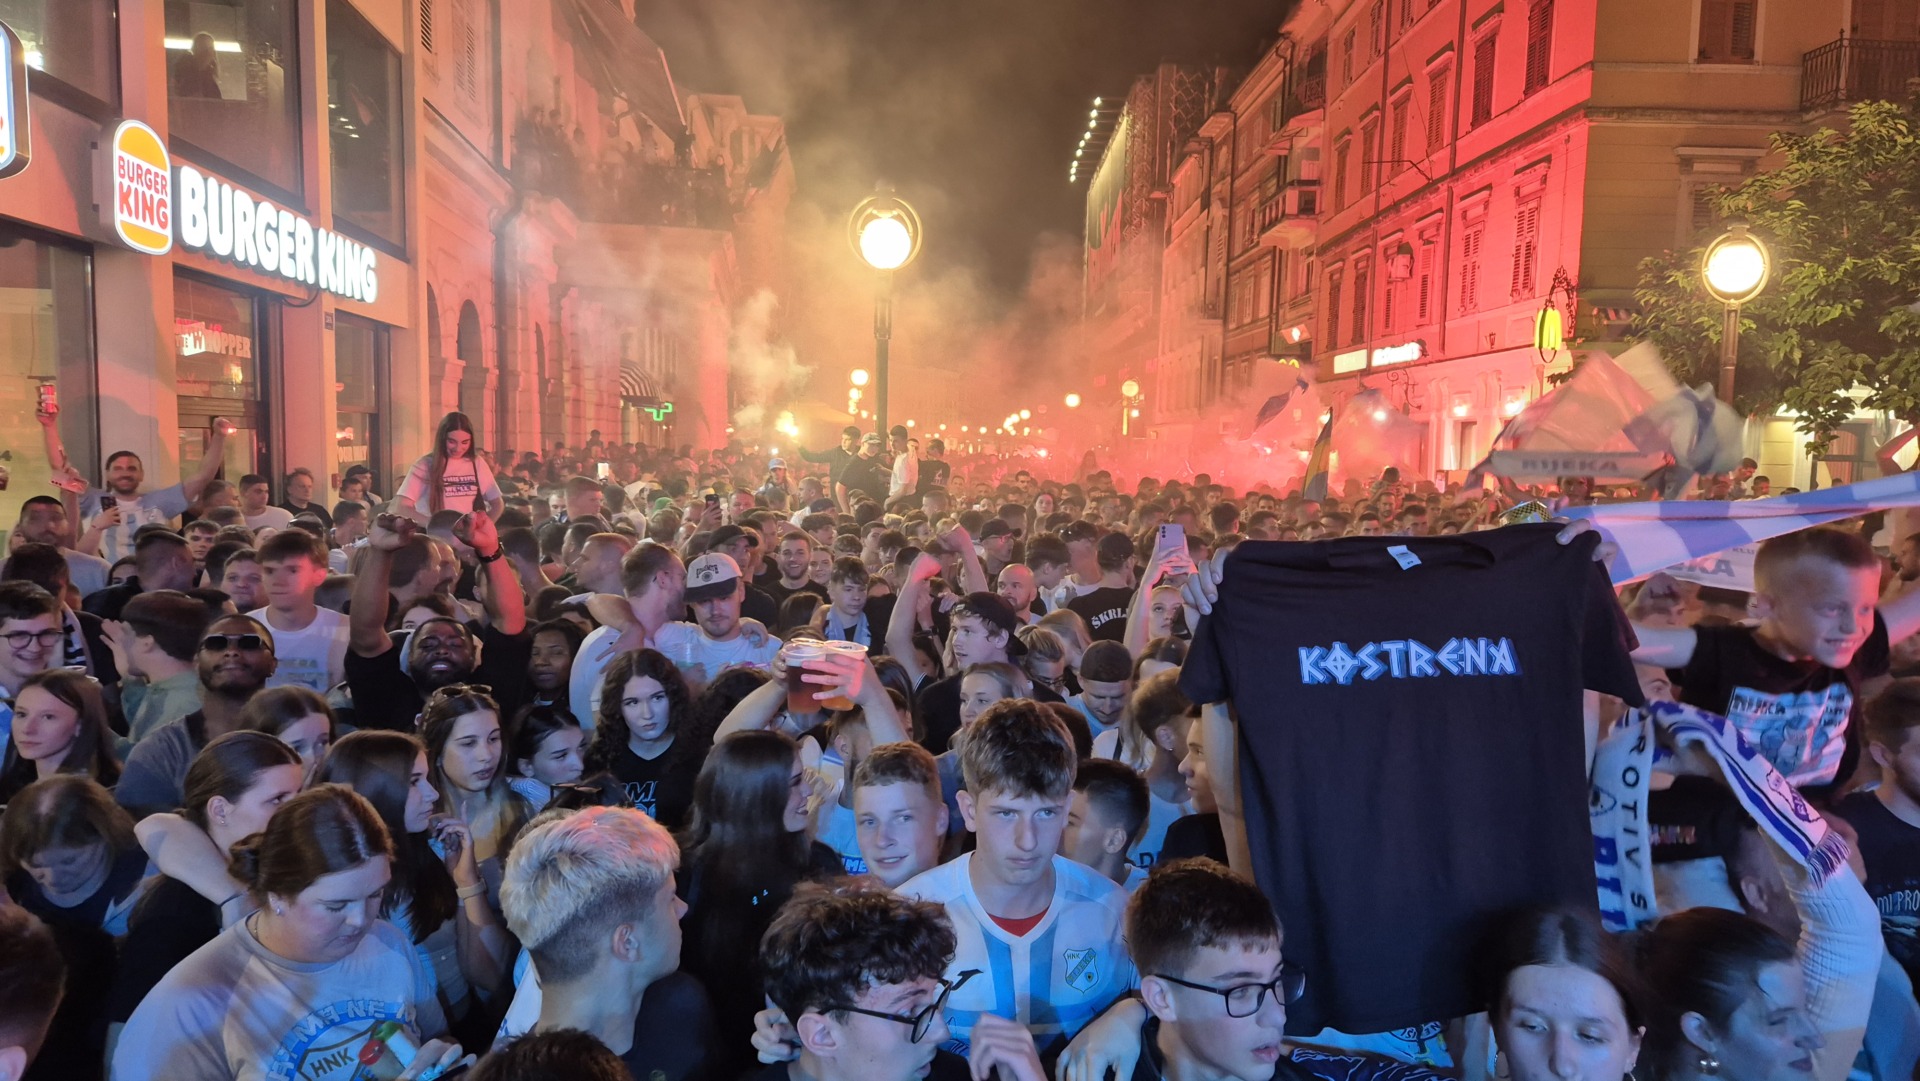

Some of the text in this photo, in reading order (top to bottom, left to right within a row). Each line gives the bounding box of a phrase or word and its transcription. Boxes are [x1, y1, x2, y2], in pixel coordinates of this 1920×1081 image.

[118, 155, 168, 198] BURGER
[118, 181, 169, 230] KING
[180, 165, 378, 304] BURGER KING
[1299, 637, 1523, 684] KOSTRENA
[309, 1047, 356, 1078] HNK
